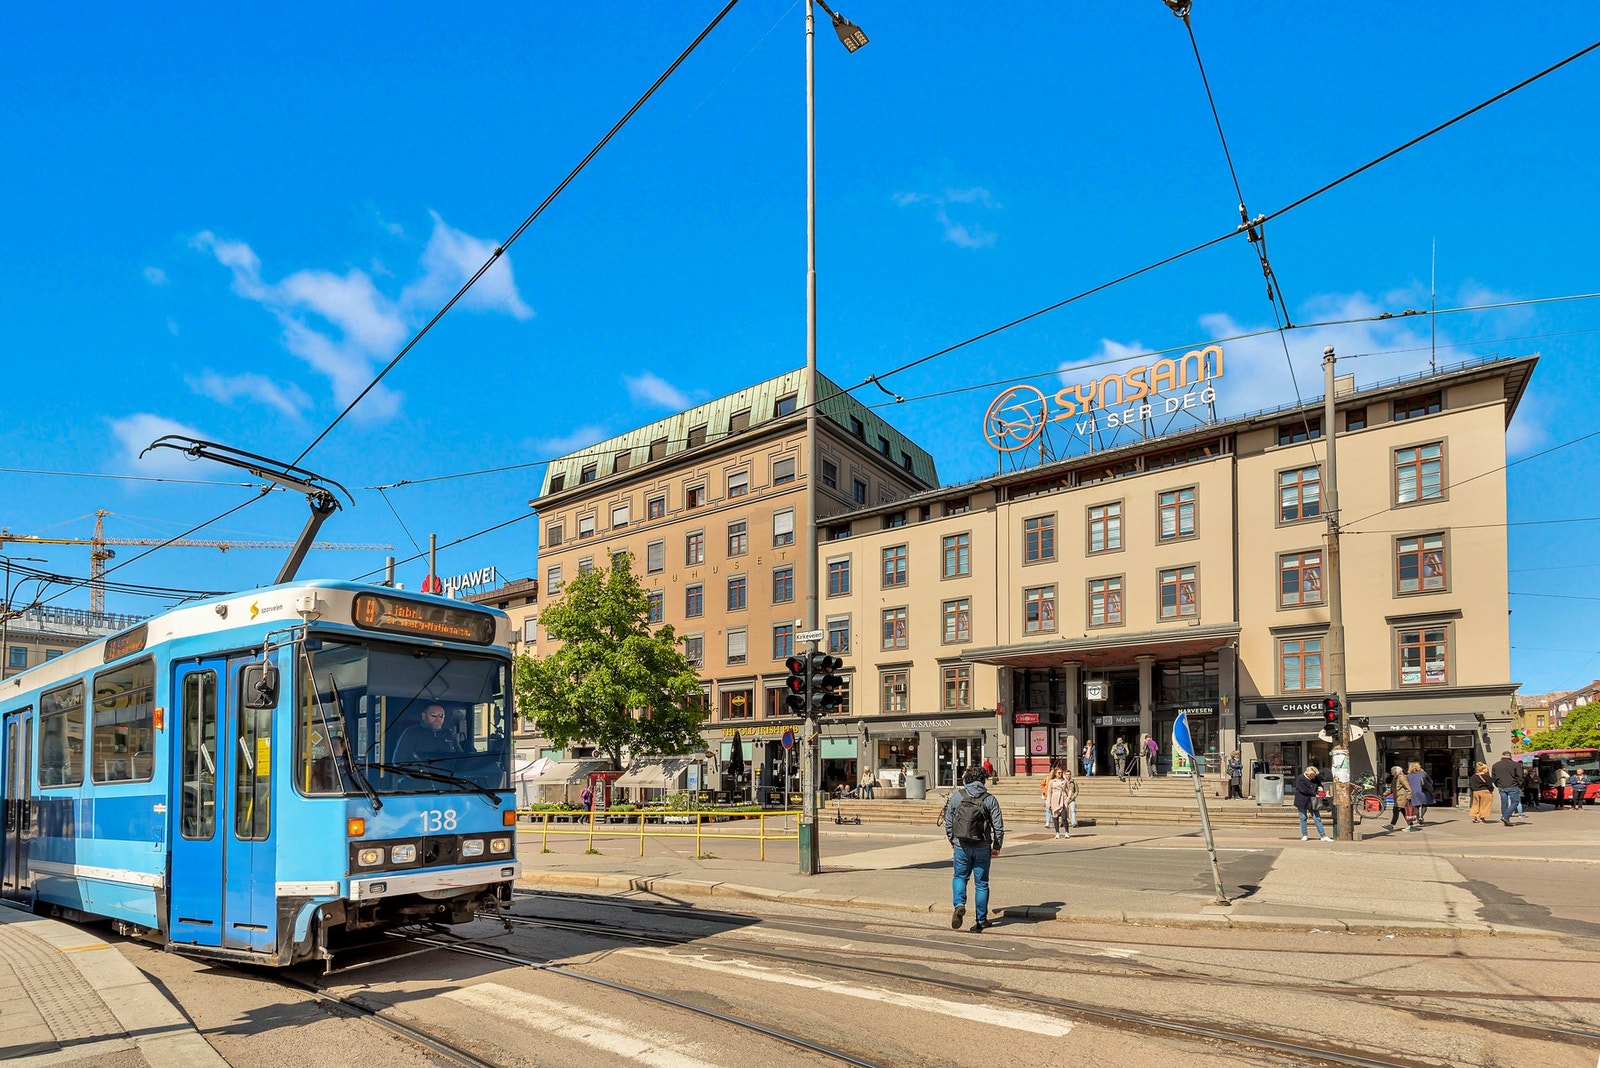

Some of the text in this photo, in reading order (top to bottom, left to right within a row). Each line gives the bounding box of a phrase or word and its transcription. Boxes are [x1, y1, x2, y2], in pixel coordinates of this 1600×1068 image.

[1055, 345, 1223, 421] SYNSAM
[1076, 388, 1216, 435] VI SER DEG
[443, 566, 496, 593] HUAWEI
[107, 611, 150, 630] KAFF
[1282, 703, 1324, 711] CHANGE
[722, 728, 737, 737] THE
[740, 727, 756, 736] OLD
[757, 725, 781, 736] IRISH
[919, 719, 952, 728] SAMSON
[420, 809, 458, 832] 138
